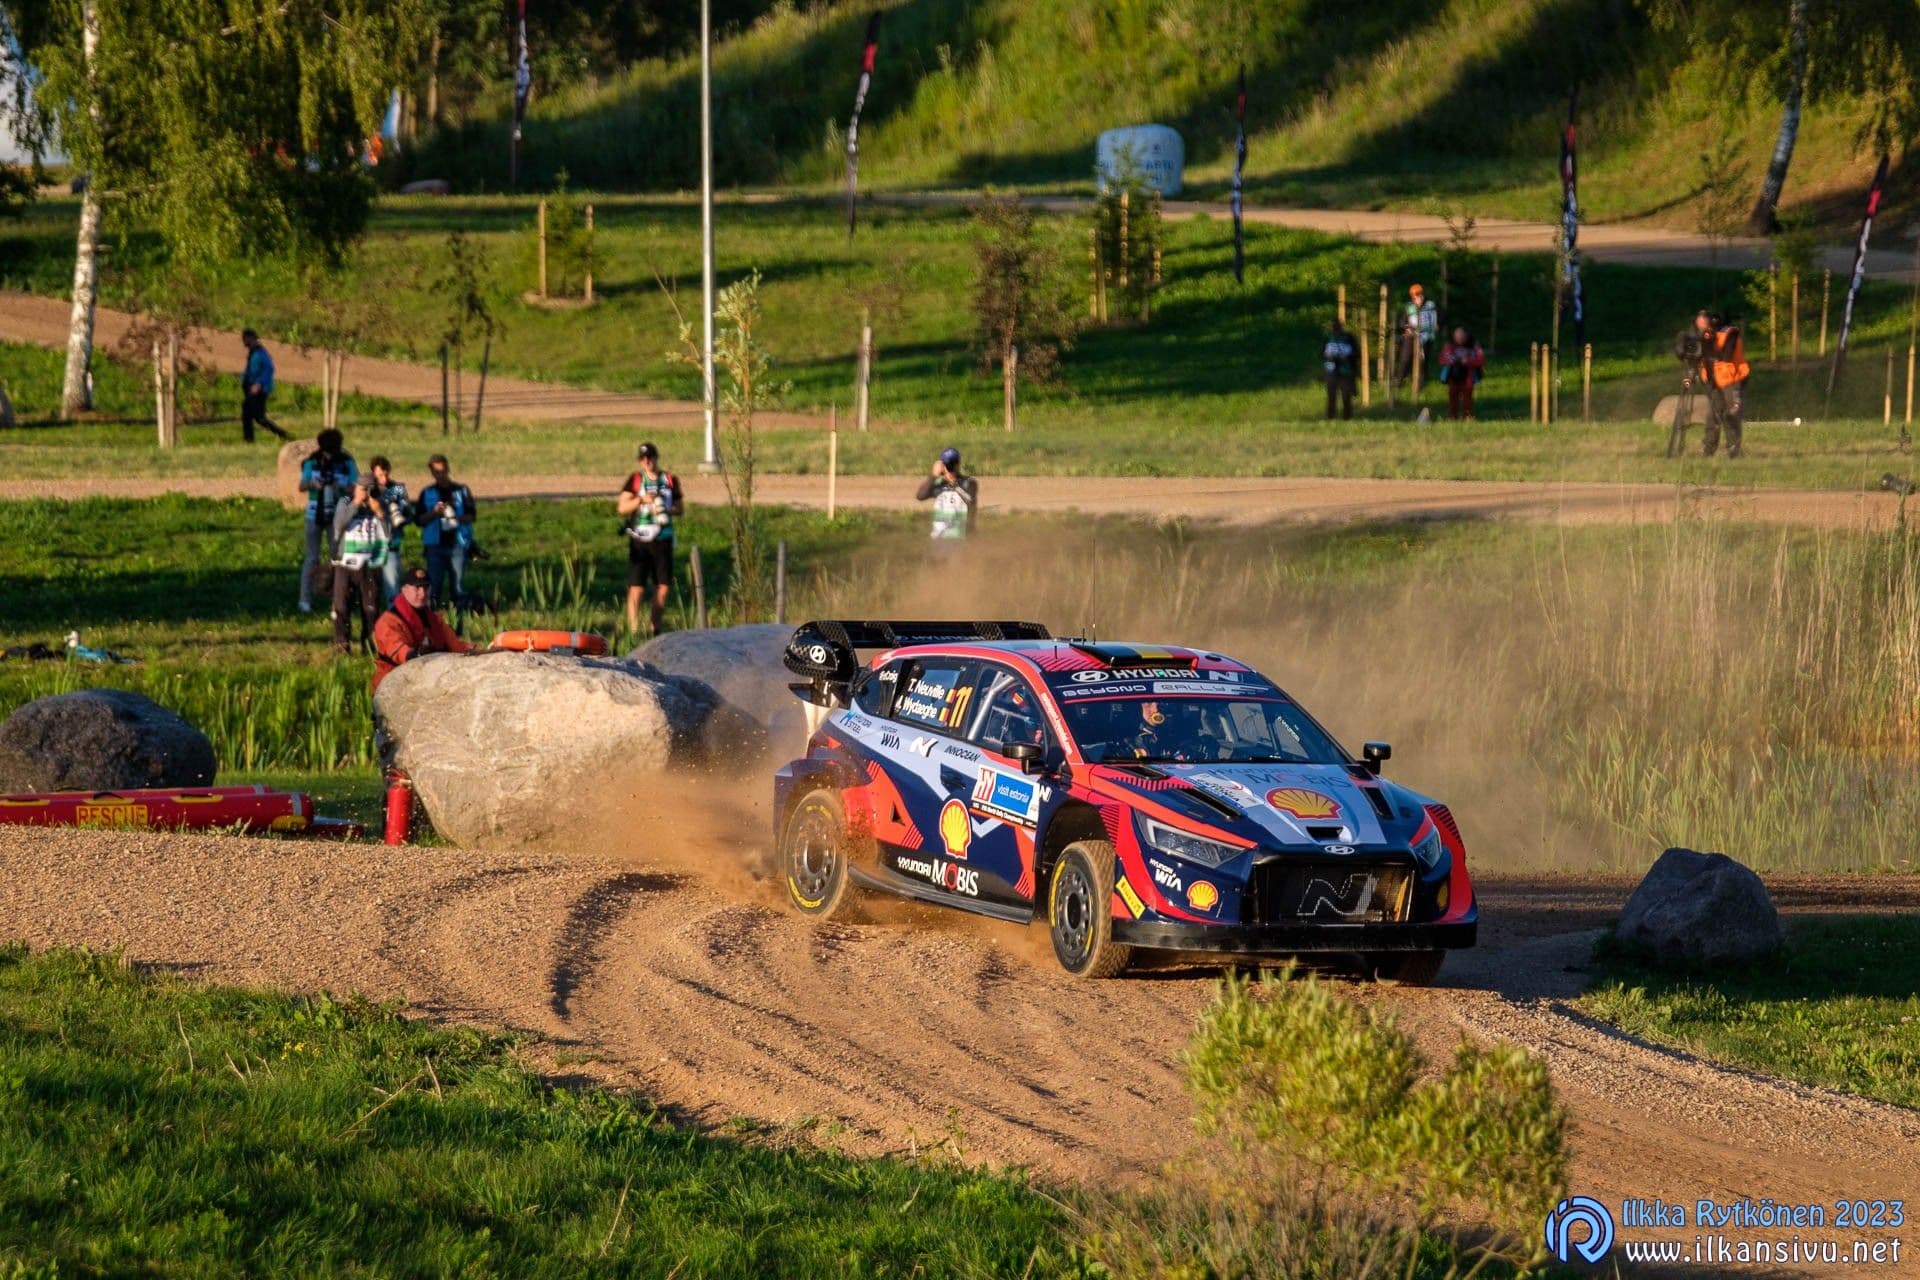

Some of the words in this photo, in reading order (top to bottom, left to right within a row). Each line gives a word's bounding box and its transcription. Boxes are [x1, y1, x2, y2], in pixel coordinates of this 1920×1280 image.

[1112, 669, 1200, 679] HYUNDAI
[915, 680, 945, 699] Neuville
[1062, 684, 1147, 697] BEYOND
[1160, 683, 1226, 693] RALLY
[903, 697, 938, 719] Wydaeghe
[949, 686, 973, 728] 11
[847, 722, 861, 734] STEEL
[881, 733, 900, 750] WIA
[944, 745, 981, 762] INNOCEAN
[997, 784, 1010, 797] visit
[1009, 789, 1030, 803] estonia
[78, 806, 147, 825] RESCUE
[898, 856, 932, 877] HYUNDAI
[931, 858, 979, 896] MOBIS
[1155, 868, 1182, 892] WIA
